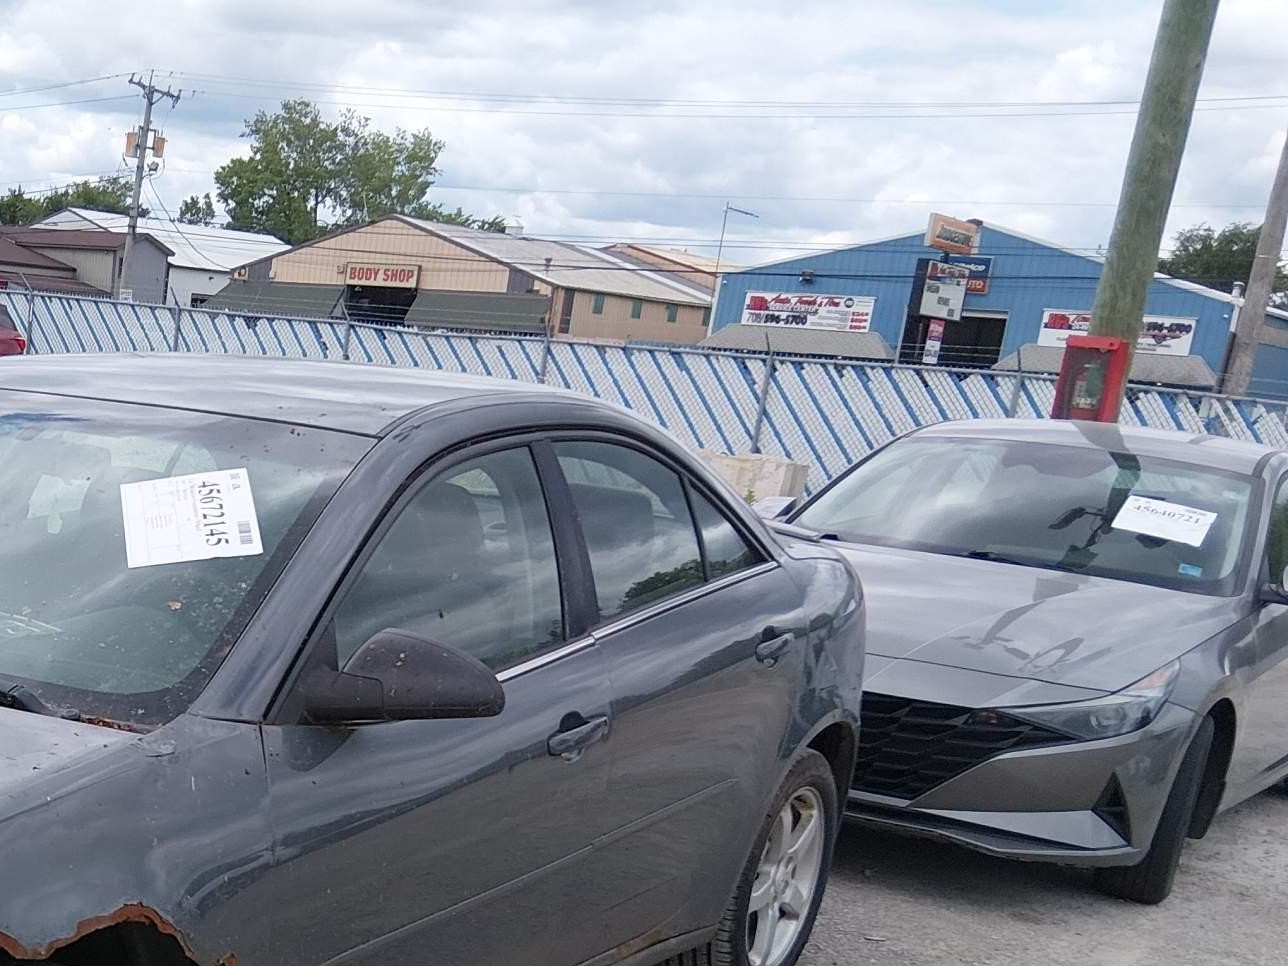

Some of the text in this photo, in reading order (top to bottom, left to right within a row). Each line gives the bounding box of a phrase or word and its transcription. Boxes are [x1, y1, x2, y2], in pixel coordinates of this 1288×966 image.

[348, 267, 415, 283] BODY SHOP
[197, 481, 230, 547] 45672145
[1133, 504, 1201, 525] 45640721
